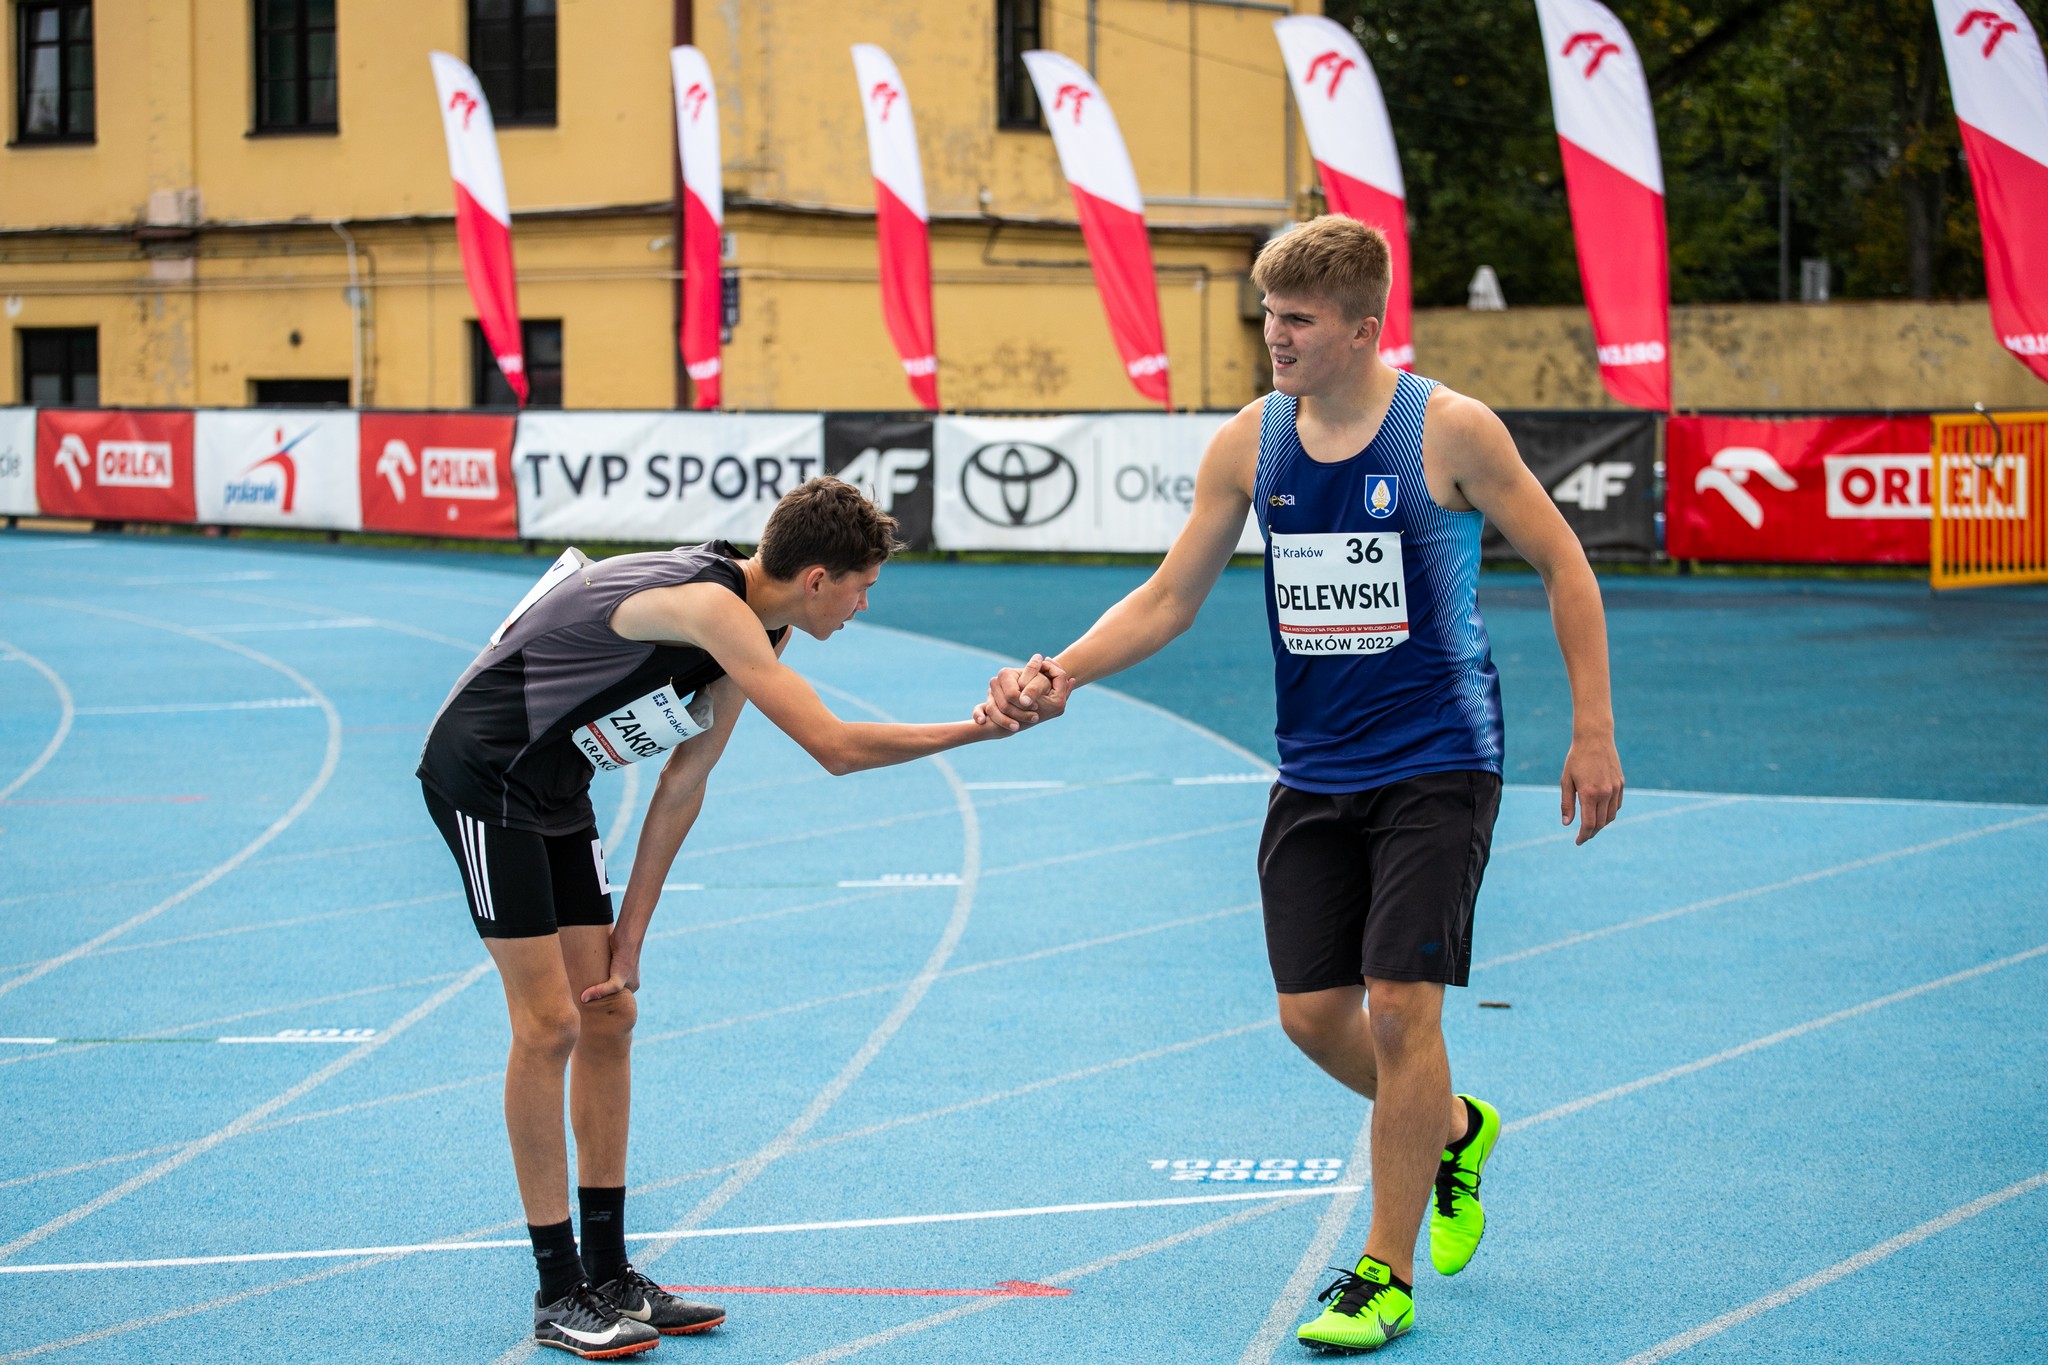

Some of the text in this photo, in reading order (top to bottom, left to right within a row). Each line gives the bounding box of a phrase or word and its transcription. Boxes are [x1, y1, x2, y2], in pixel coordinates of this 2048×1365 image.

[525, 454, 816, 500] TVP SPORT
[836, 447, 931, 513] 4F
[1553, 462, 1635, 509] 4F
[1841, 466, 2015, 507] ORLEN
[1282, 547, 1323, 558] Kraków
[1346, 538, 1383, 564] 36
[1277, 582, 1400, 610] DELEWSKI
[1288, 635, 1395, 650] KRAKÓW 2022
[663, 707, 690, 737] Kraków
[580, 737, 621, 771] KRAKÓ
